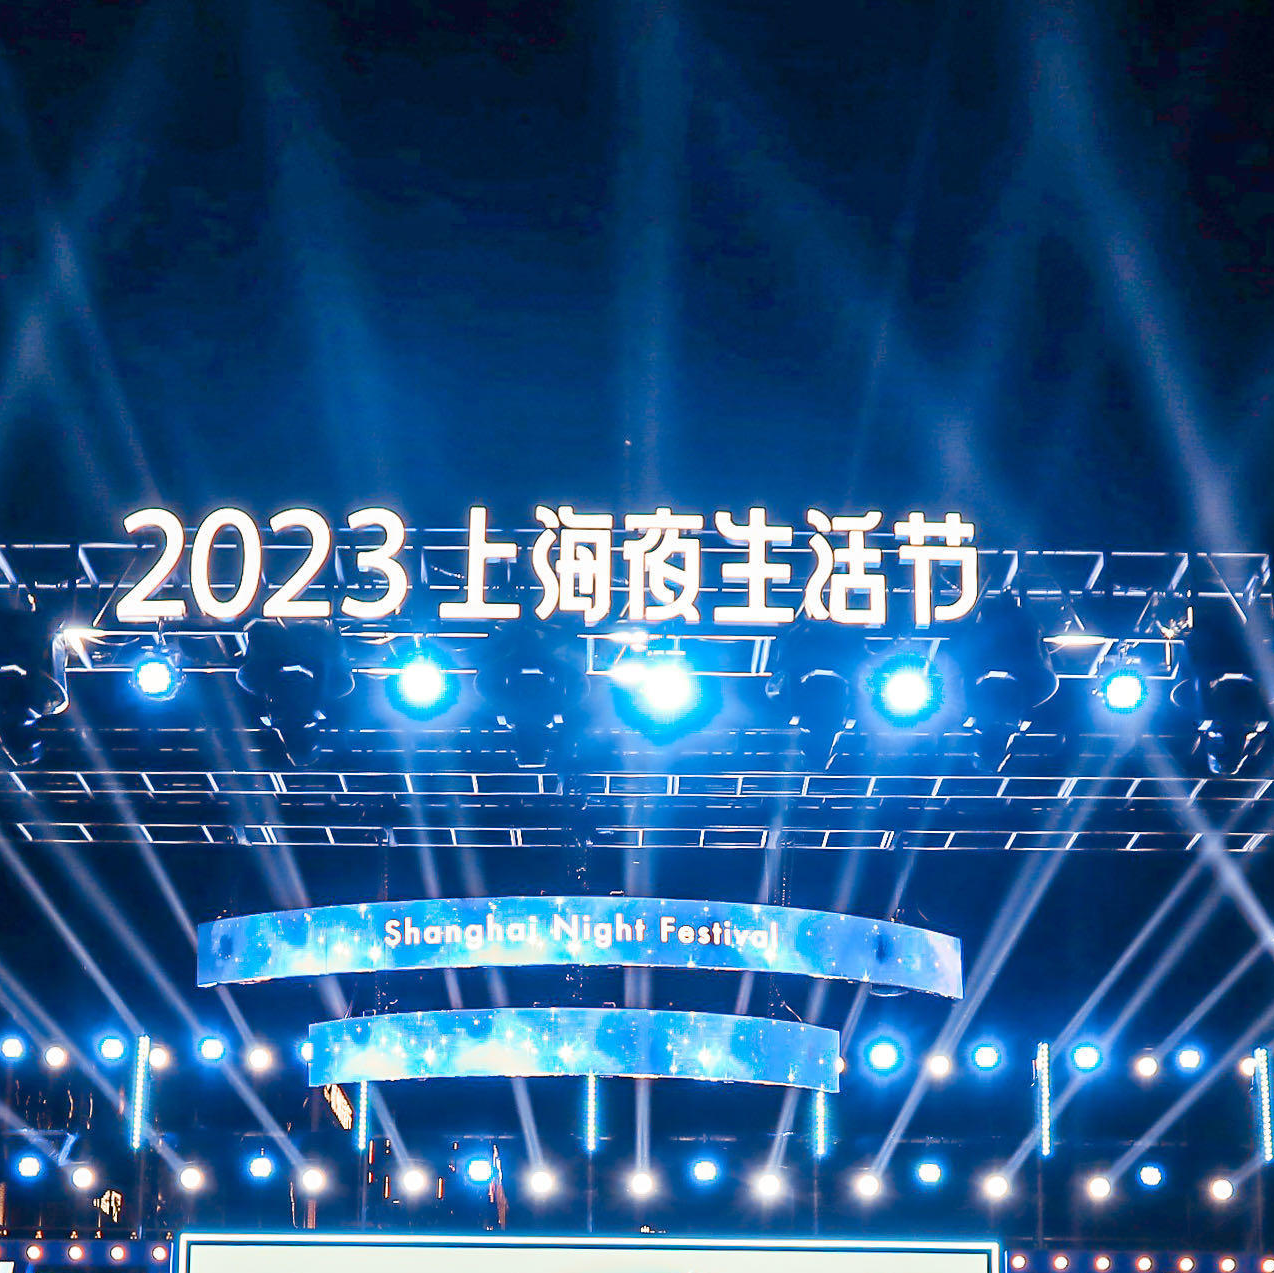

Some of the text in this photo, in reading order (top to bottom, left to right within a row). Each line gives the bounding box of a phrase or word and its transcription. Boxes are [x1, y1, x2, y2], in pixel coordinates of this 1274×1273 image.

[117, 505, 979, 623] 2023 上海夜生活节
[383, 913, 779, 949] Shanghai Night Festival
